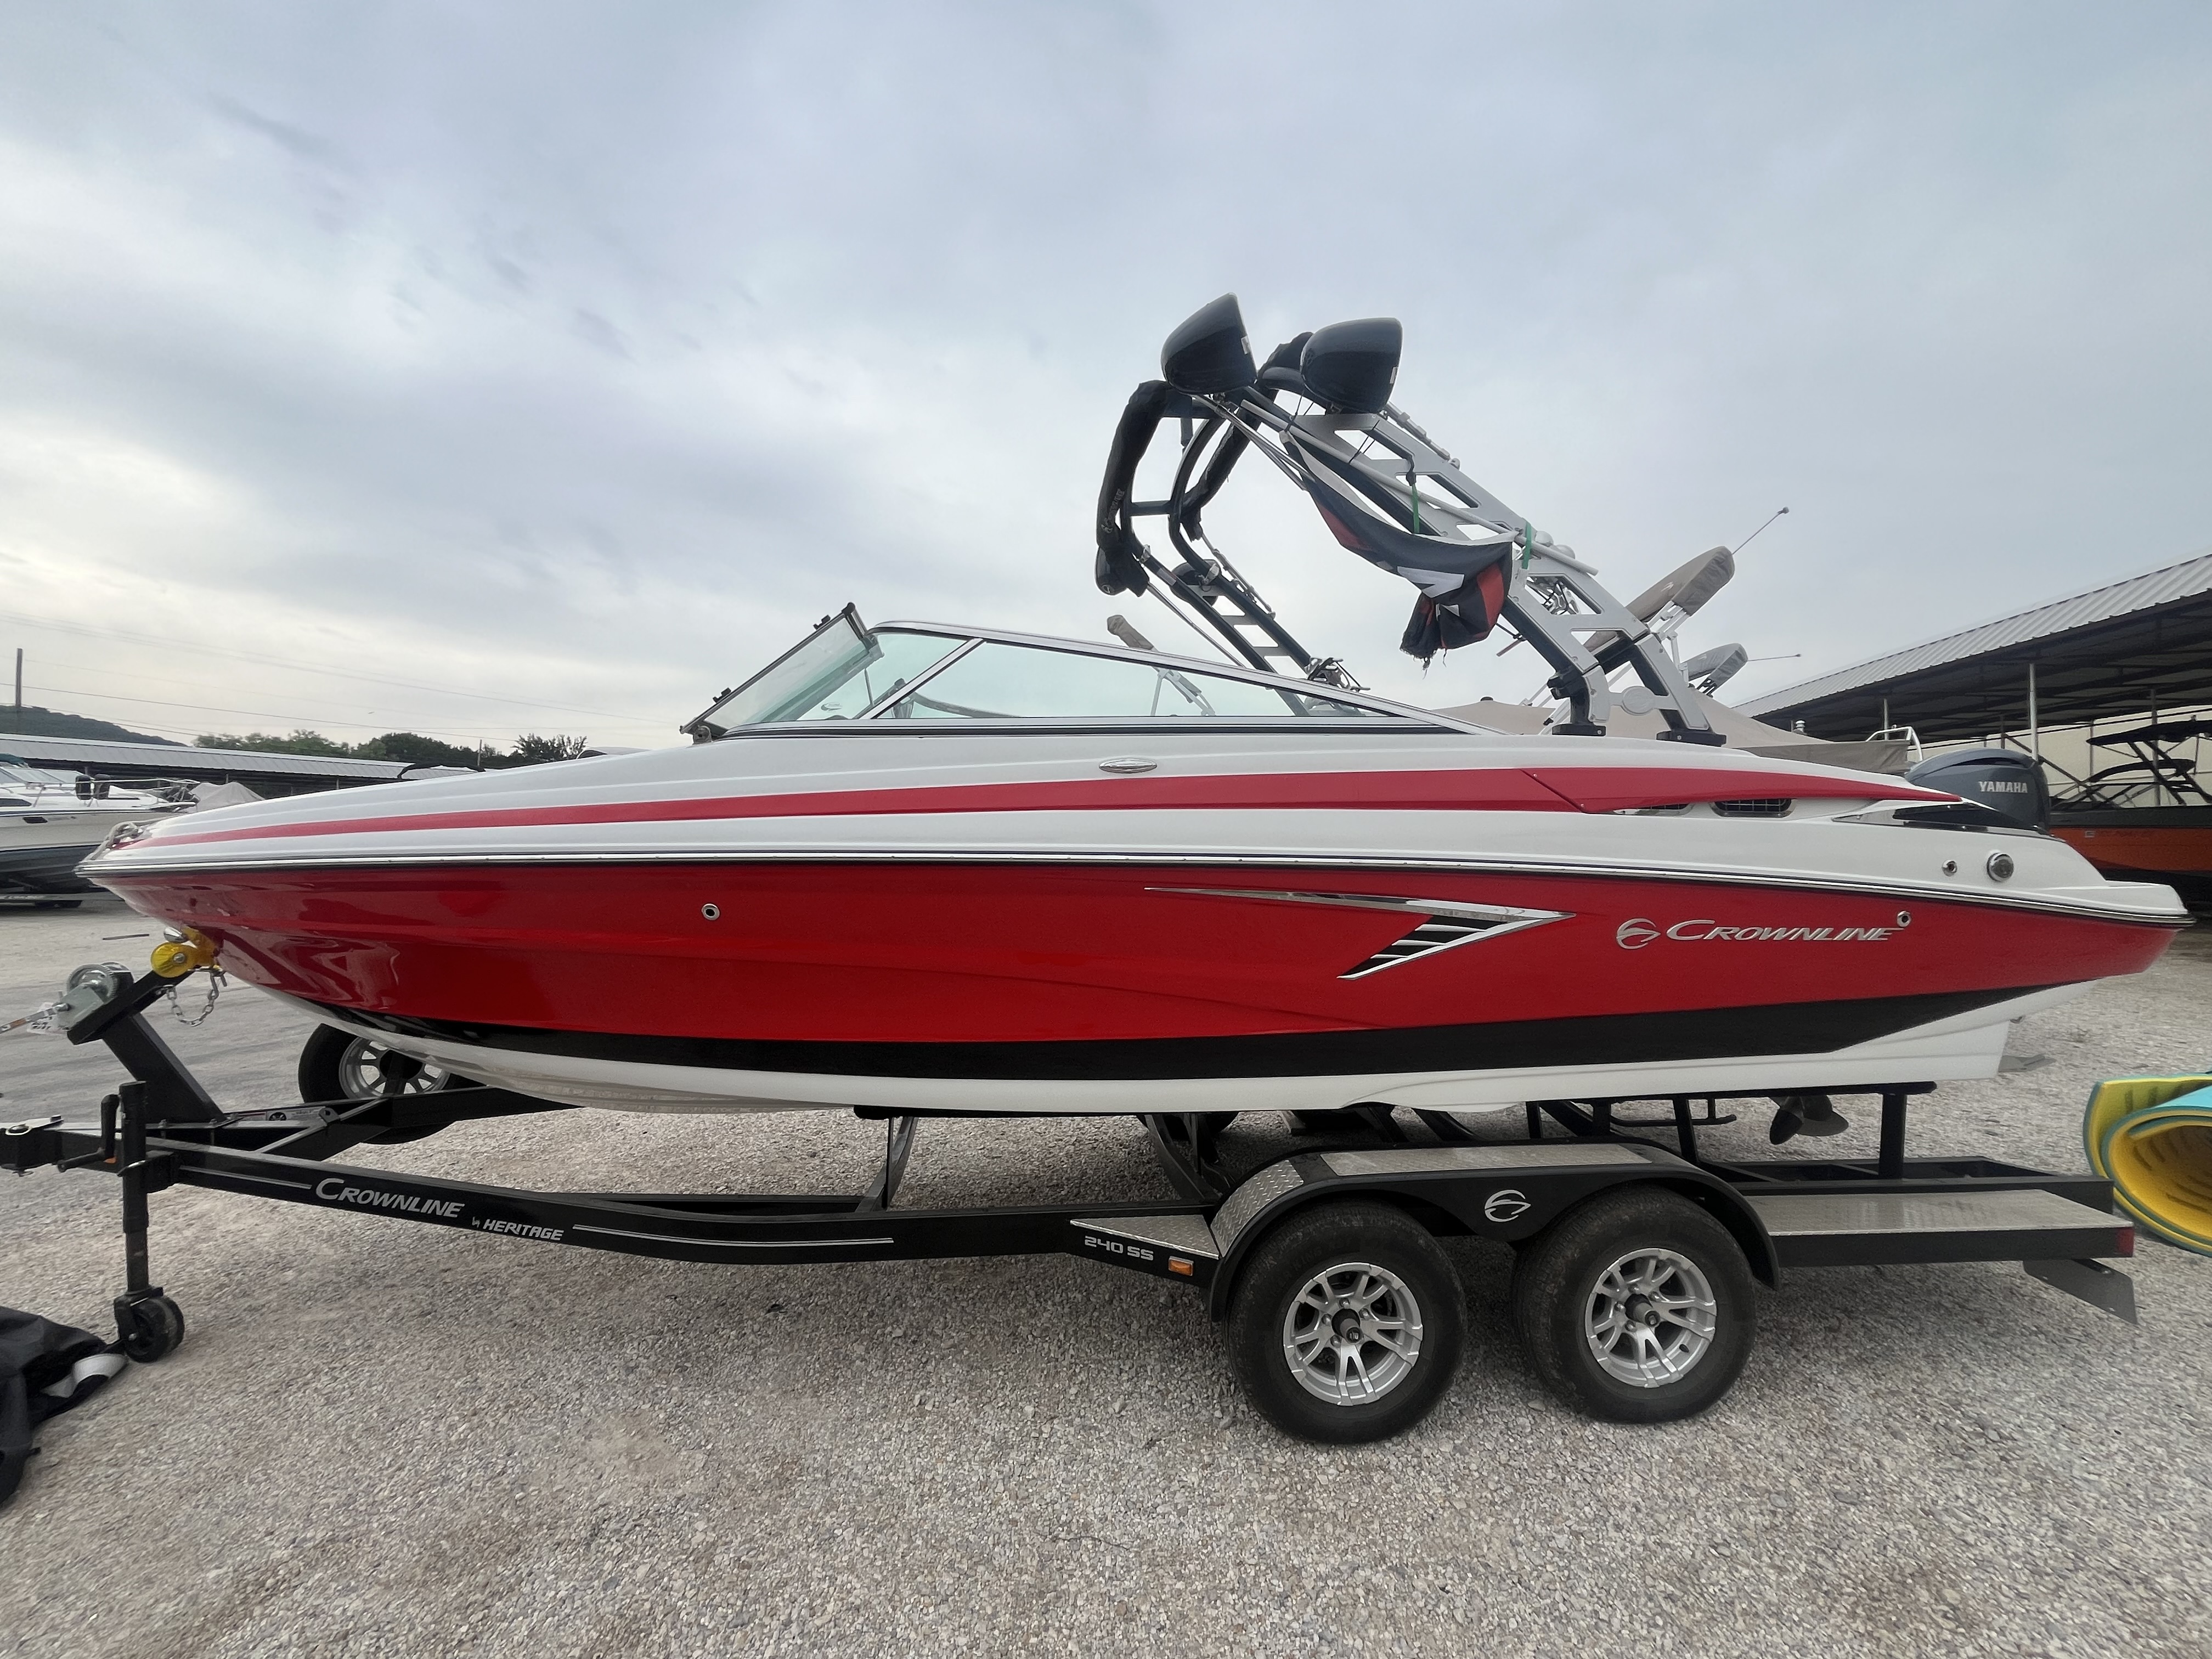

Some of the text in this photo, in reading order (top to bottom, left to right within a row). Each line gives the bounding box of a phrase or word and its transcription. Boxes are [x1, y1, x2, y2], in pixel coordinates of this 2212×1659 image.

[1978, 781, 2028, 793] YAMAHA
[483, 1219, 564, 1240] HERITAGE
[1085, 1236, 1153, 1260] 240 SS
